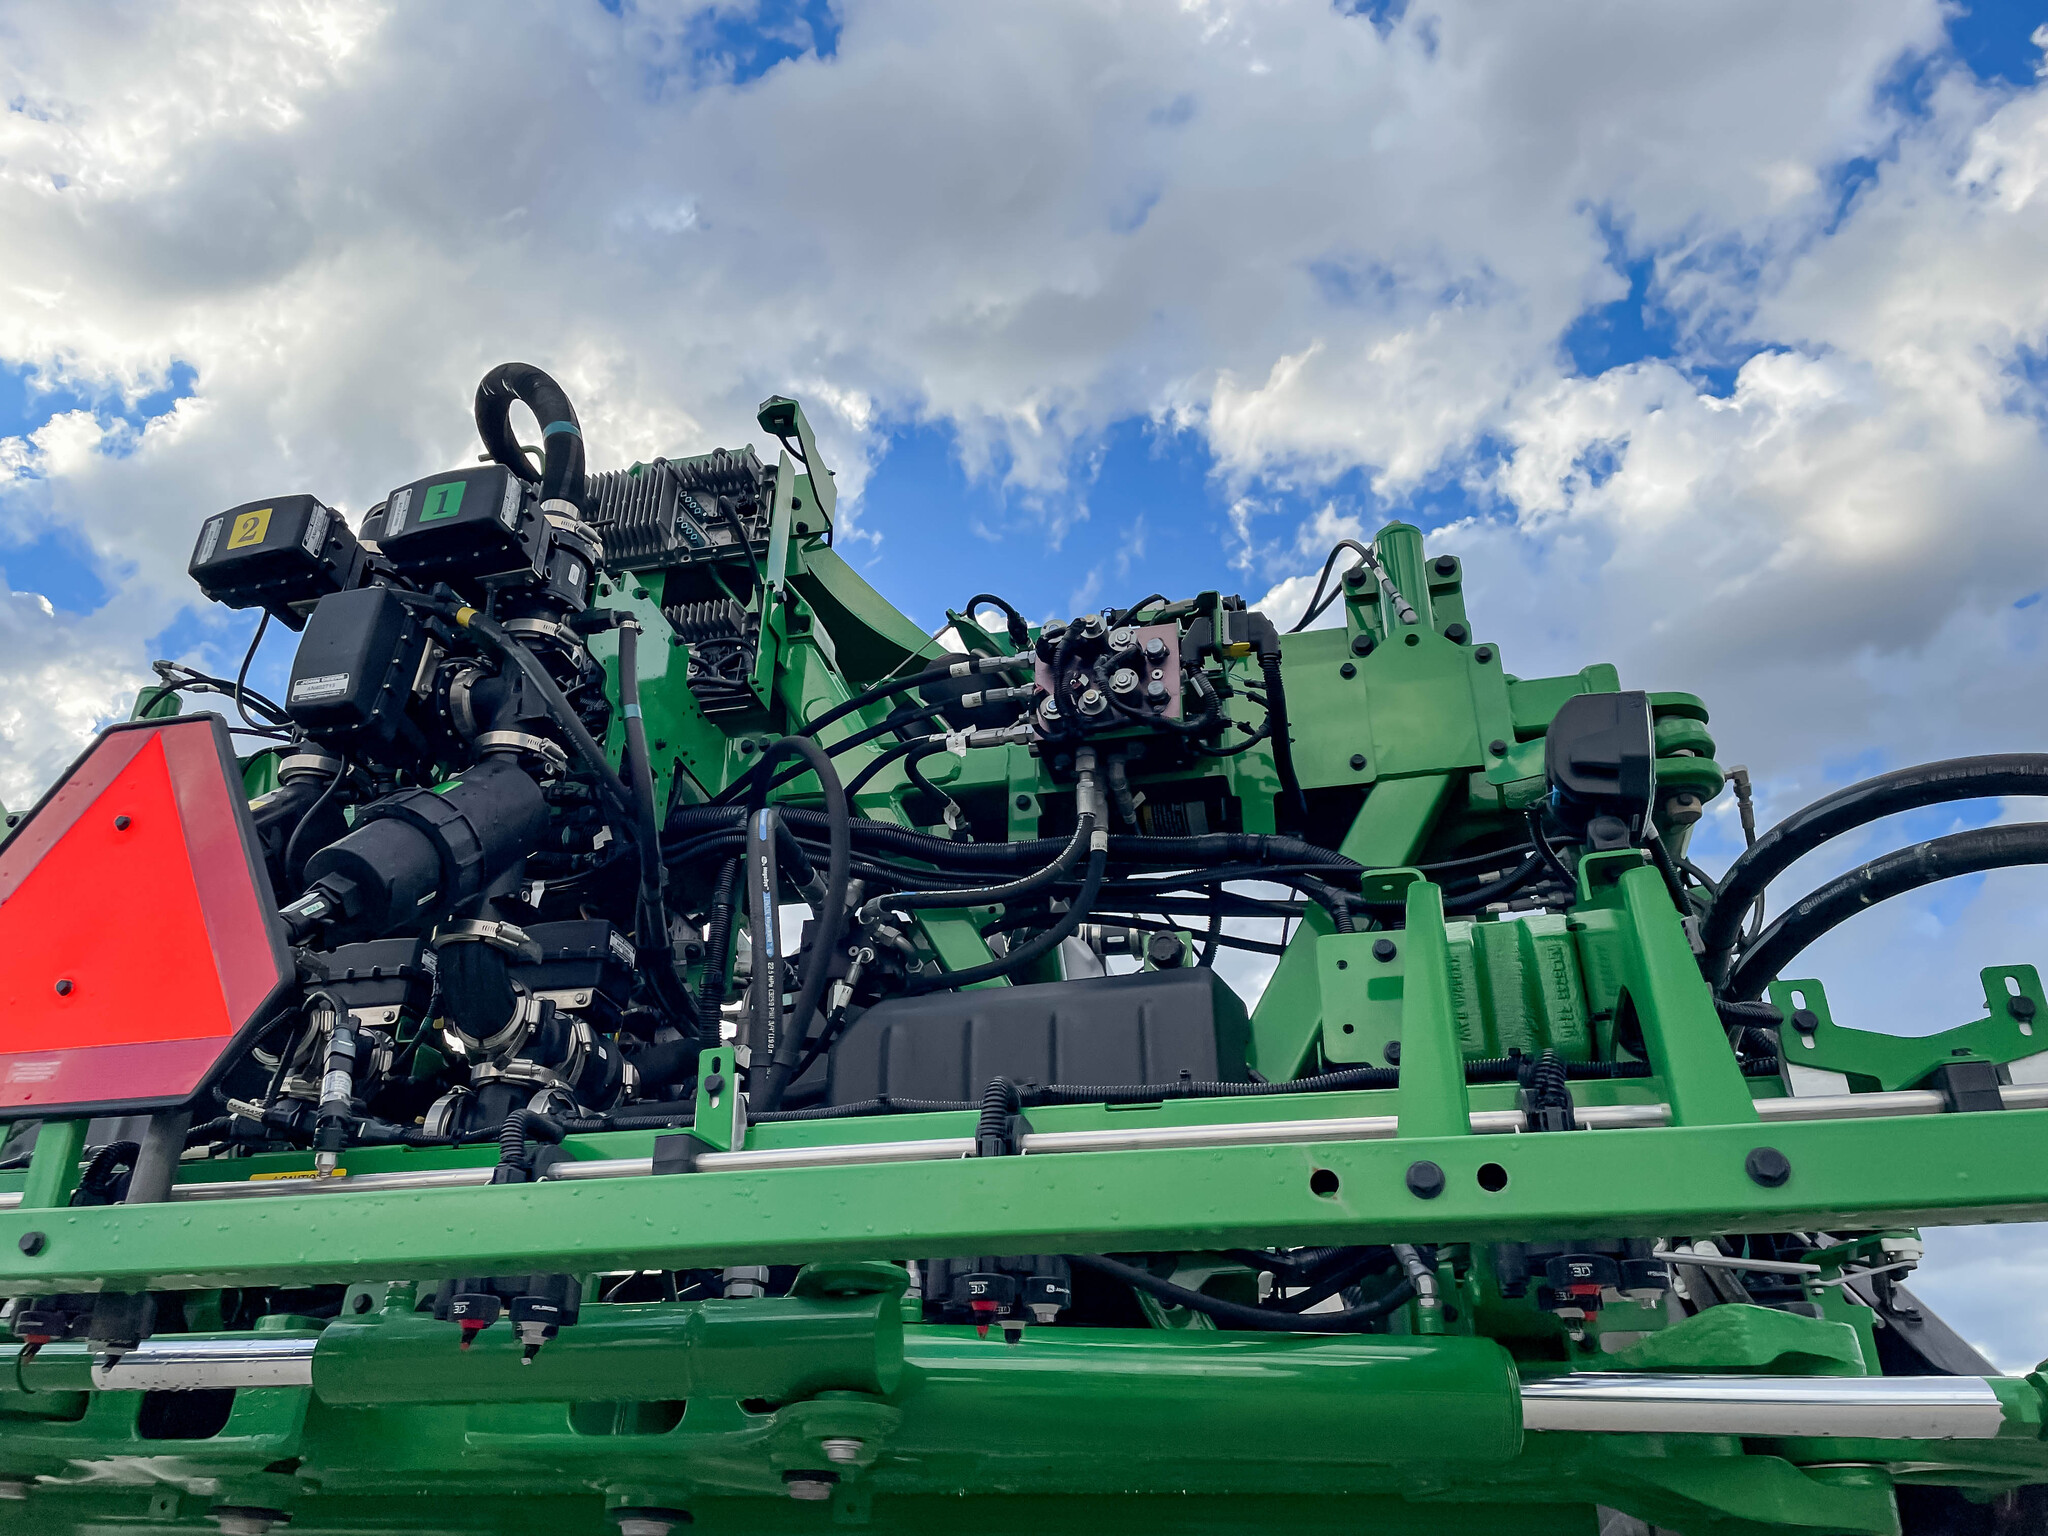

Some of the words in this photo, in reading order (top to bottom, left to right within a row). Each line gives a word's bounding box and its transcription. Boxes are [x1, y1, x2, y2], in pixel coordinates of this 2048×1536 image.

[432, 489, 449, 515] 1
[238, 516, 260, 543] 2
[453, 1305, 467, 1314] 3D
